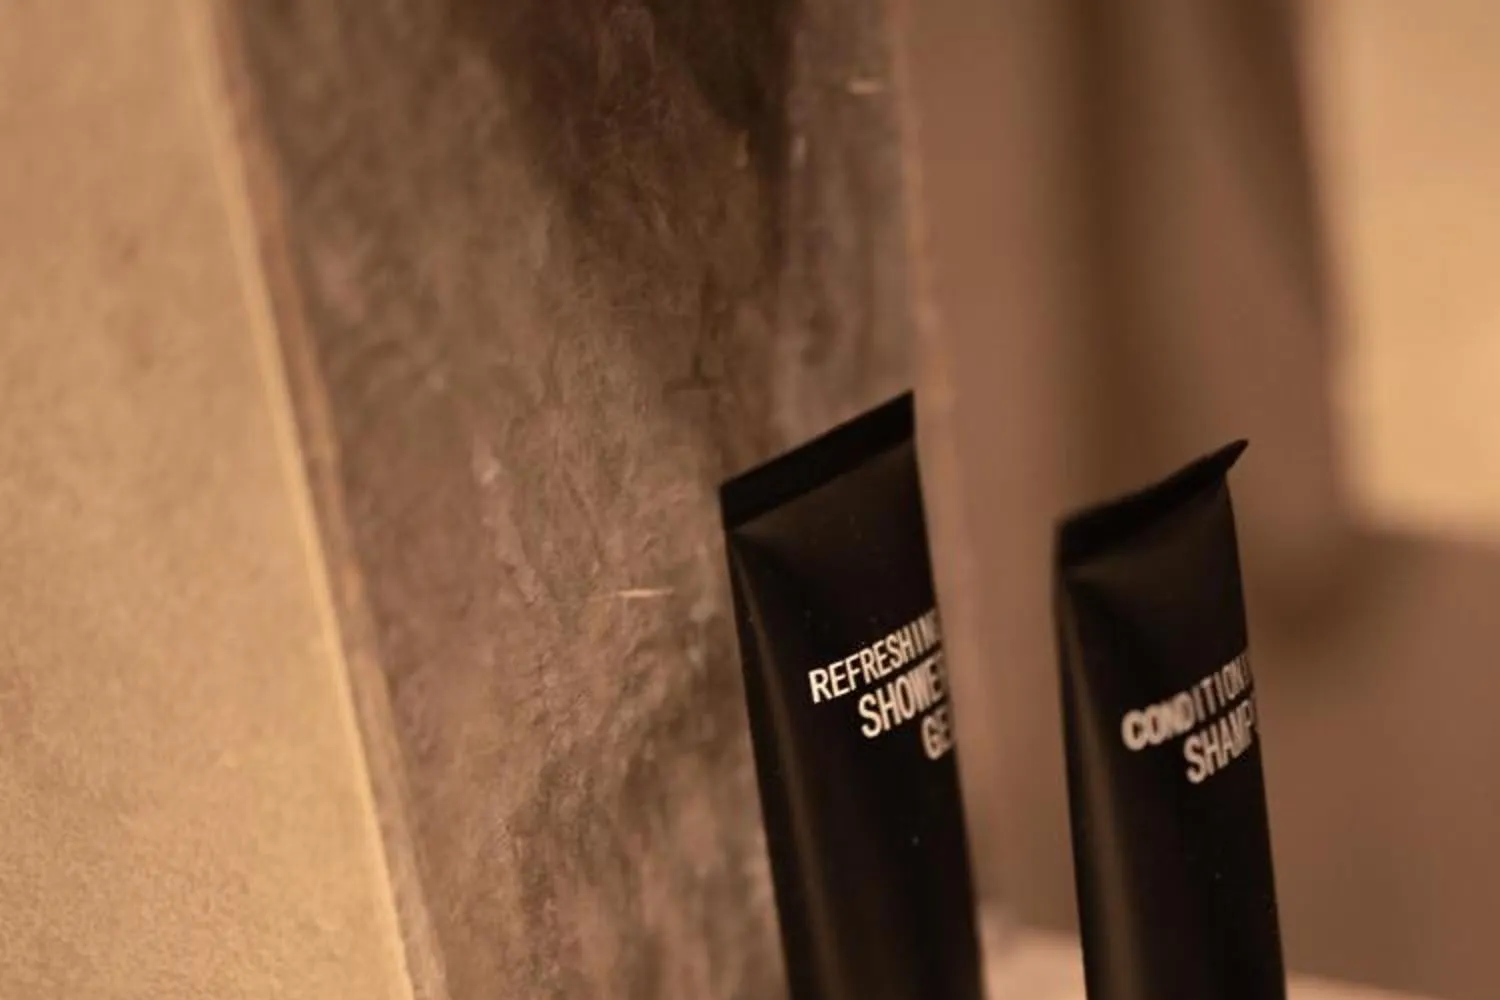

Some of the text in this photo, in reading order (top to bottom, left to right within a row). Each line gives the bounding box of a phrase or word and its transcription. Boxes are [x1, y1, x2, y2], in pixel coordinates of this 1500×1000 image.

[808, 609, 944, 704] REFRESHIN
[858, 652, 947, 738] SHOWE
[1184, 699, 1255, 784] SHAMP
